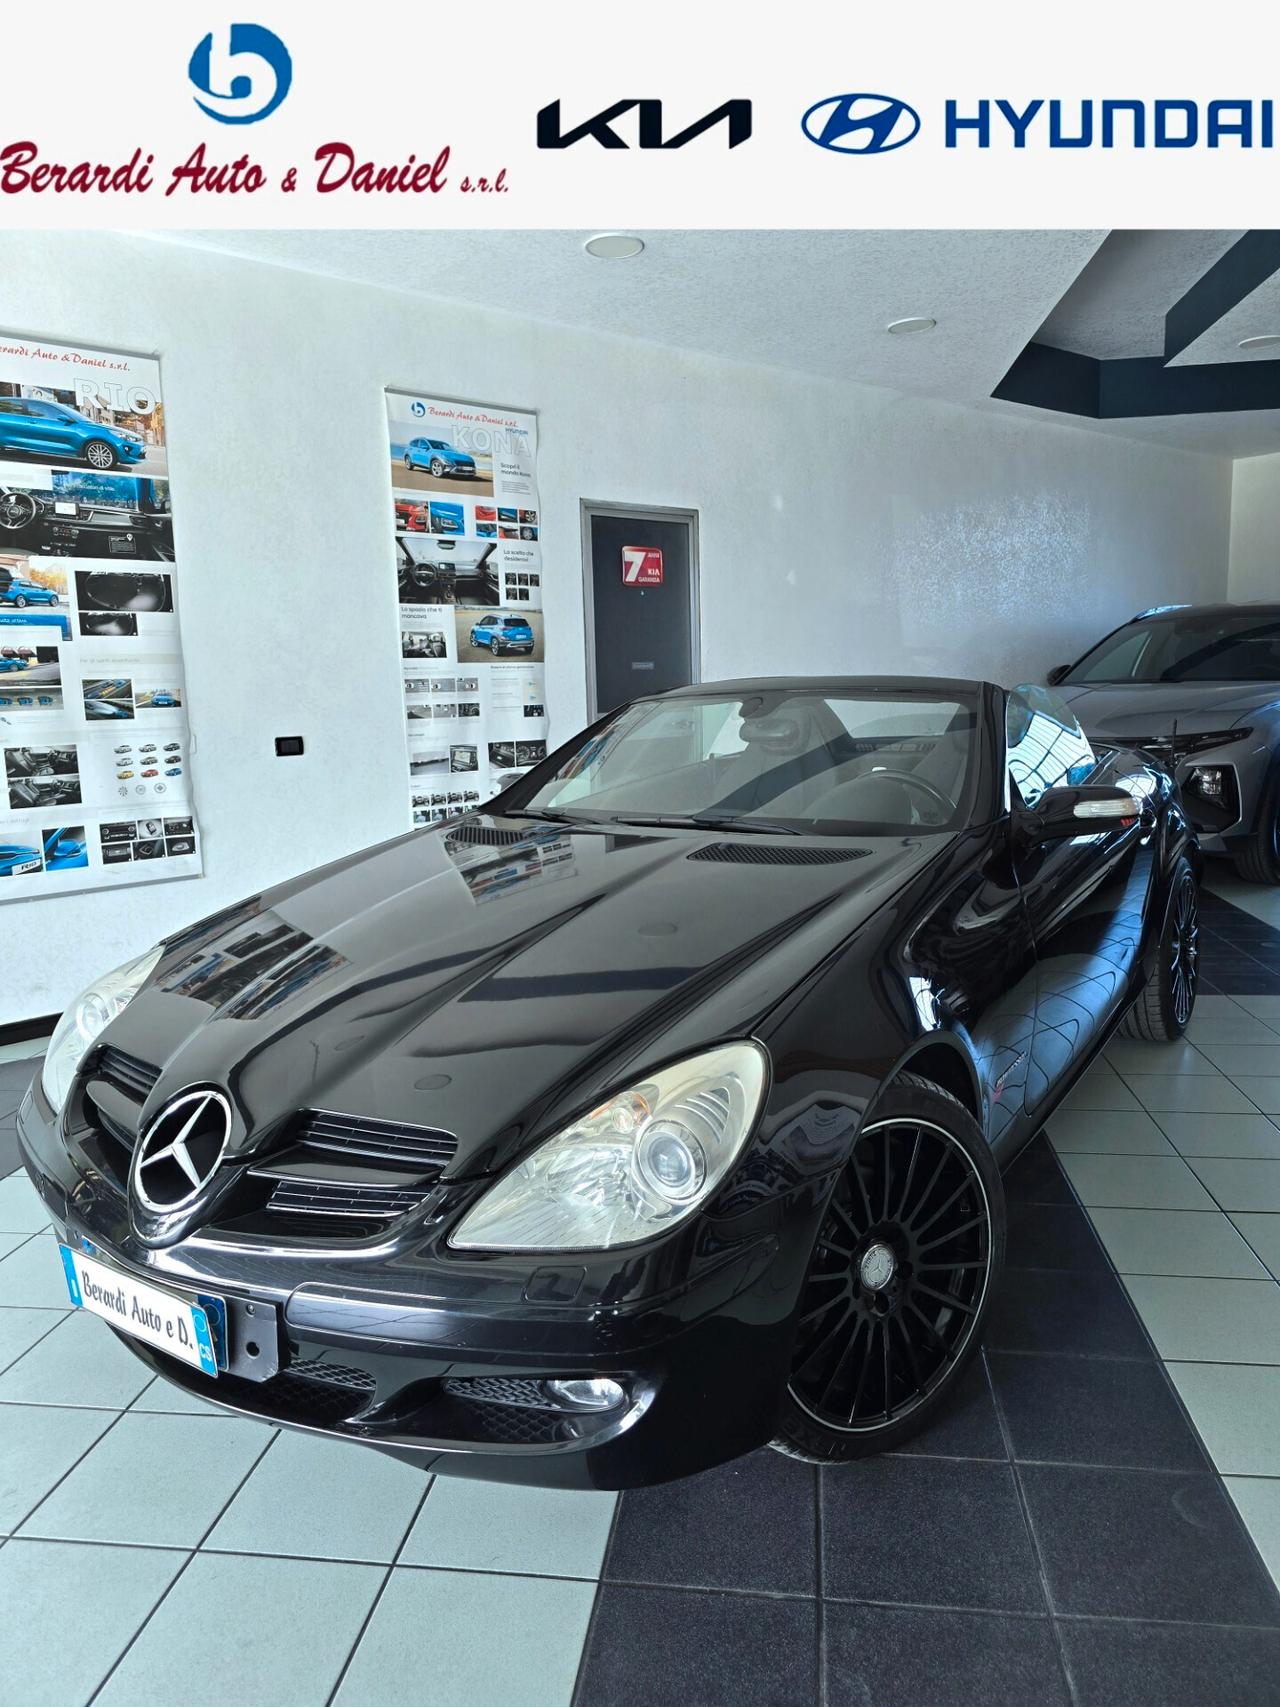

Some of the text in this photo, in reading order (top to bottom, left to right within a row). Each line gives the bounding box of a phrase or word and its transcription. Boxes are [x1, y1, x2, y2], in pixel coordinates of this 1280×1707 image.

[31, 348, 58, 360] Auto
[73, 377, 156, 415] RIO
[451, 423, 532, 458] KONA
[624, 551, 647, 582] 7
[647, 568, 660, 576] KIA
[82, 1270, 194, 1350] Berardi Auto e D.
